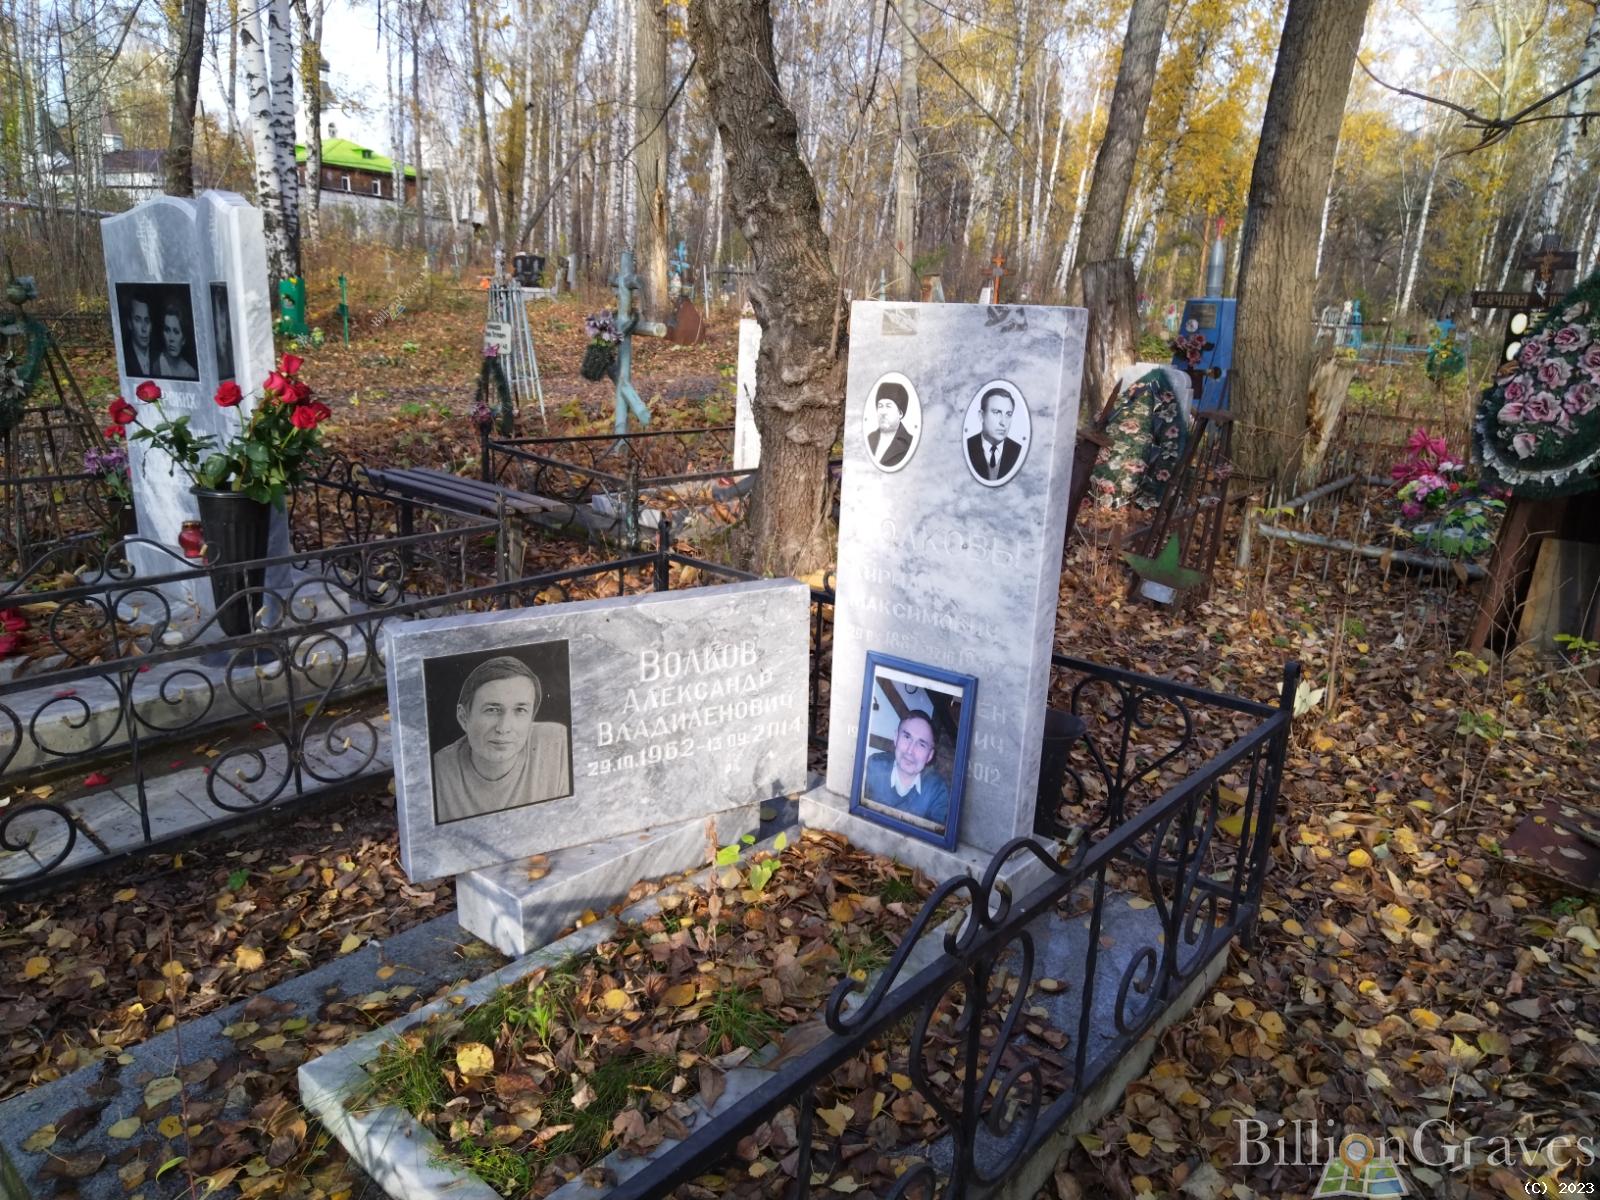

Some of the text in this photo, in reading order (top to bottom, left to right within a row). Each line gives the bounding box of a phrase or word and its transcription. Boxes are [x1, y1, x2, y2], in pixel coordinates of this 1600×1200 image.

[640, 640, 758, 683] ВОЛКОВ
[622, 669, 773, 714] АЛЕКСАНДР
[598, 693, 794, 747] ВЛАДИЛЕНОВИЧ
